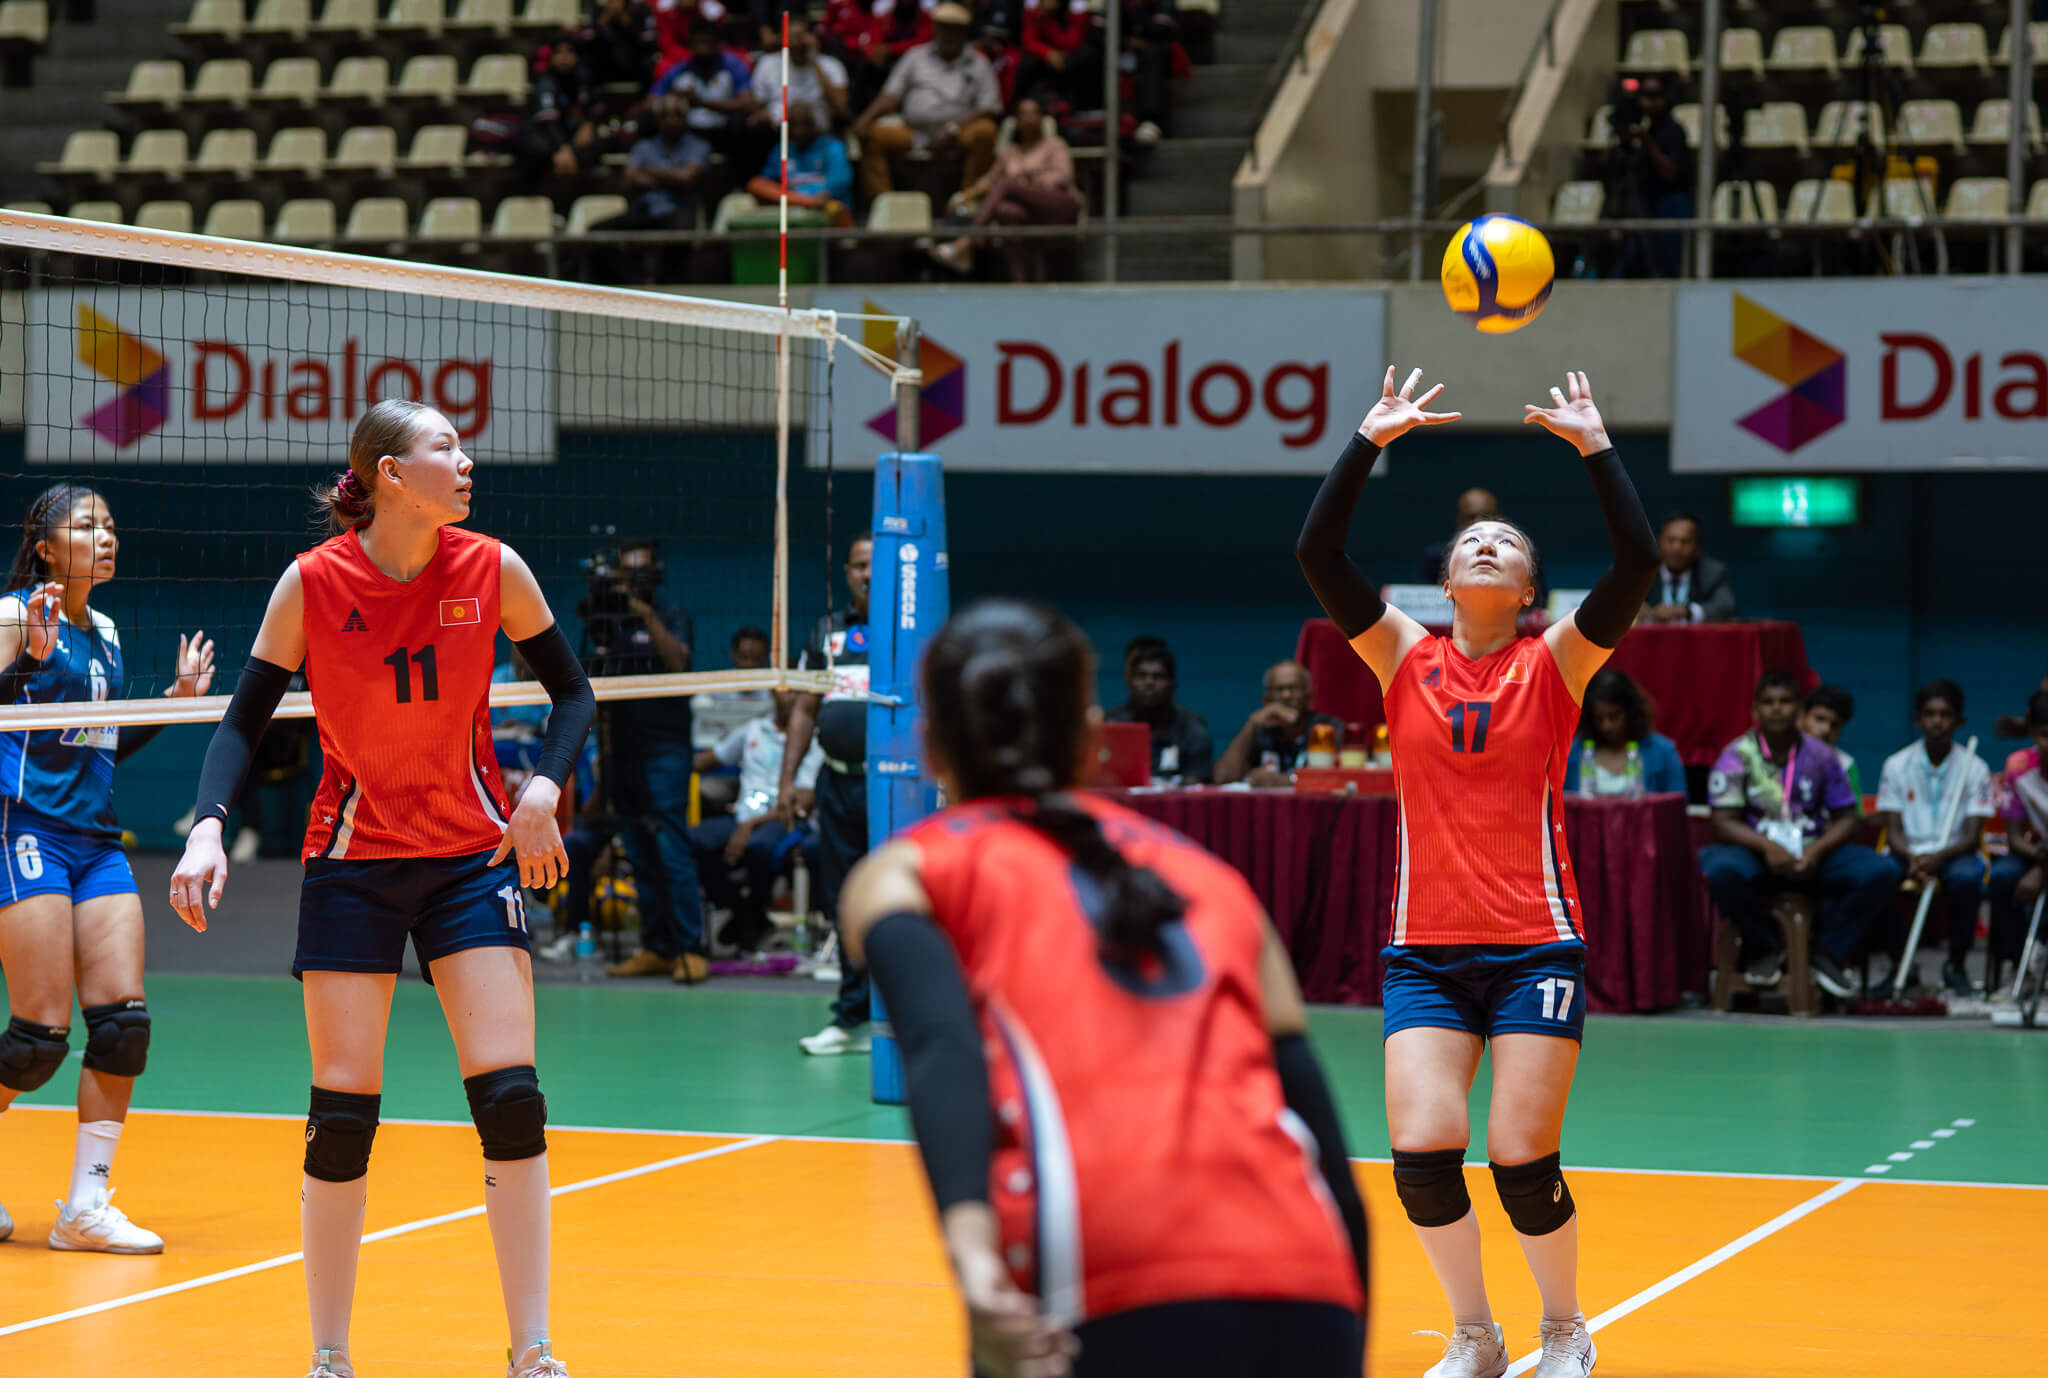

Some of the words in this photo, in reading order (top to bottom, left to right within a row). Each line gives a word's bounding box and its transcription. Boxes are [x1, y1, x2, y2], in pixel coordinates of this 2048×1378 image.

[192, 336, 493, 440] Dialog
[995, 338, 1330, 450] Dialog
[1878, 330, 2048, 423] Dia
[383, 643, 439, 704] 11
[1445, 701, 1492, 753] 17
[15, 834, 44, 880] 6
[1537, 978, 1575, 1022] 17
